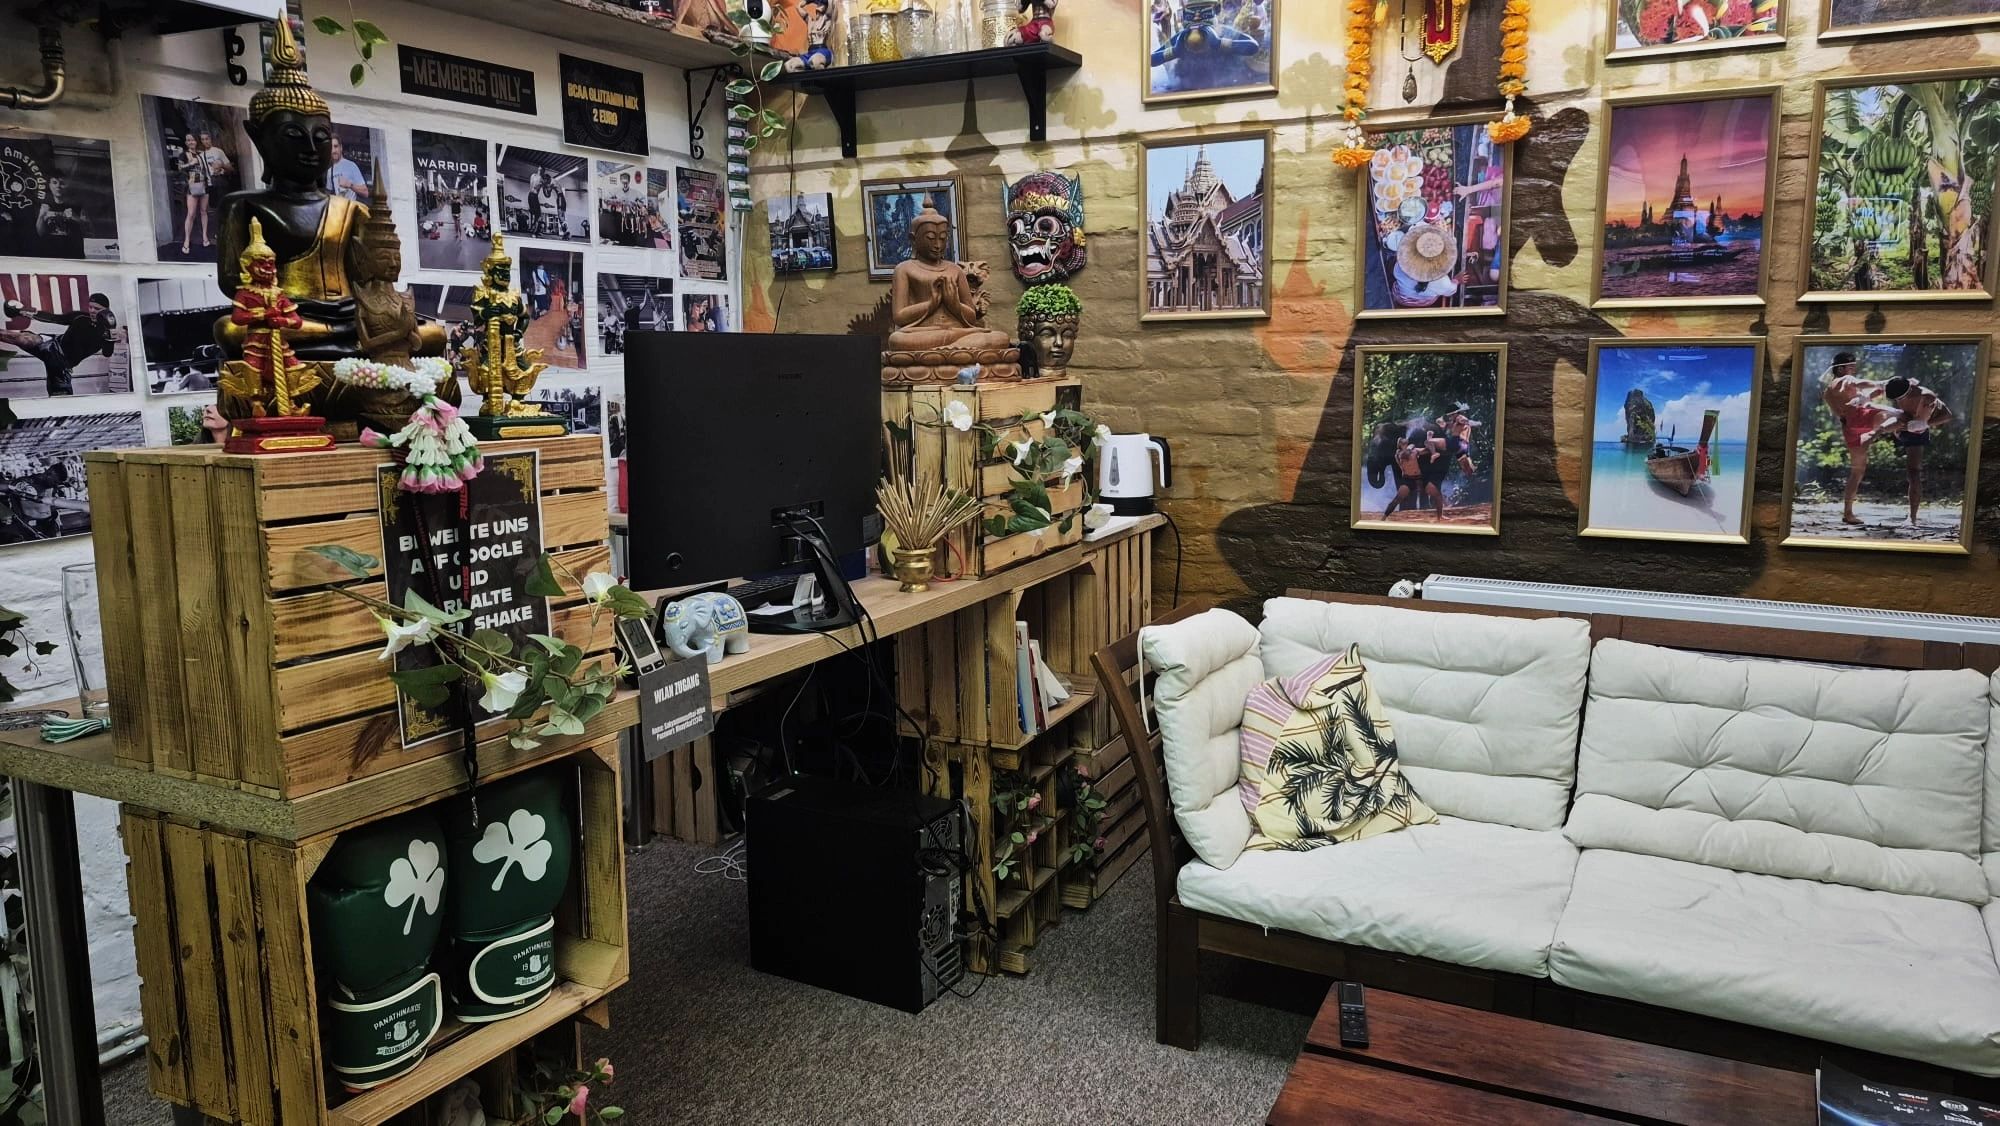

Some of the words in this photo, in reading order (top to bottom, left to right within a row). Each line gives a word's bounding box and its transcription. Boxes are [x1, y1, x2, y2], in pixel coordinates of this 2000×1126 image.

[412, 56, 487, 96] MEMBERS
[490, 71, 521, 102] ONLY
[588, 88, 624, 108] GLUTAMIN
[592, 108, 599, 122] 2
[599, 109, 618, 126] EURO
[4, 146, 47, 200] Amsterdam
[417, 157, 478, 174] WARRIOR
[399, 522, 490, 552] BWETE
[493, 517, 529, 536] UNS
[410, 552, 449, 575] AF
[474, 605, 533, 631] SHAKE
[654, 684, 674, 705] WLAN
[674, 673, 700, 696] ZUGANG
[384, 1031, 392, 1041] 19
